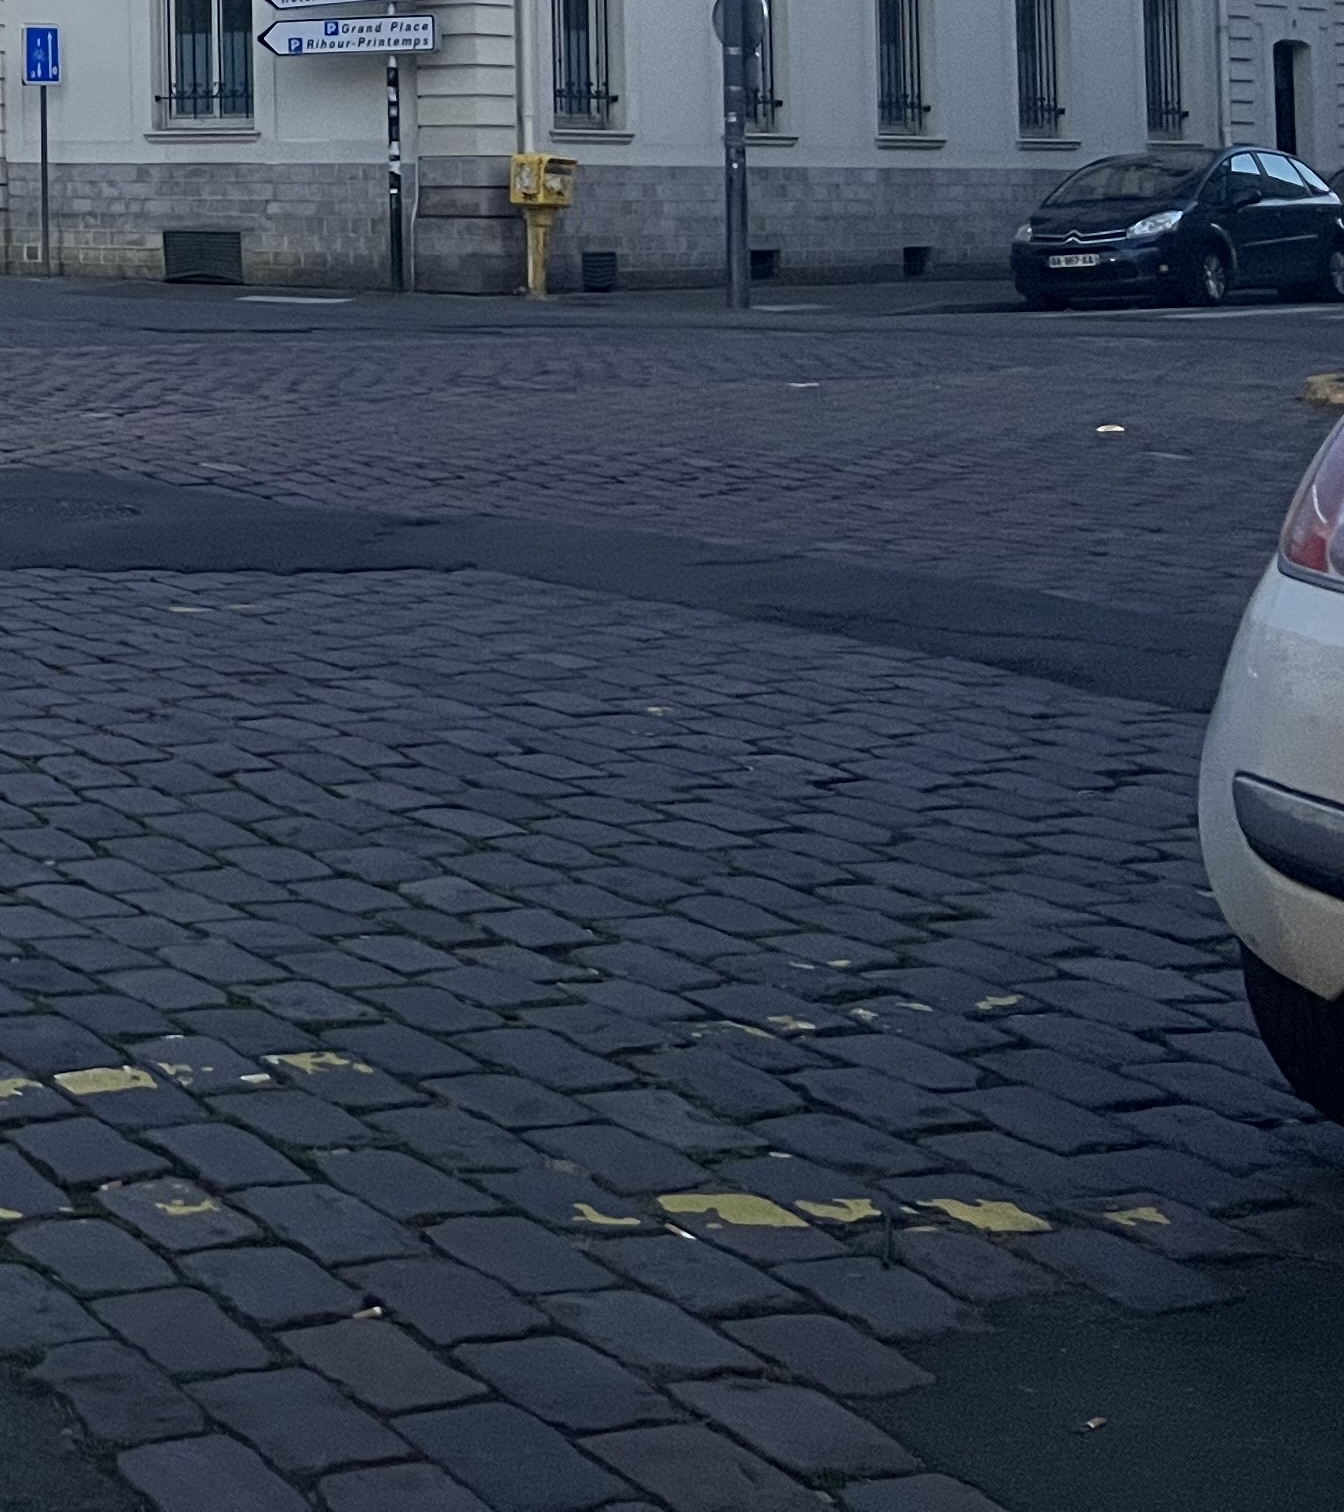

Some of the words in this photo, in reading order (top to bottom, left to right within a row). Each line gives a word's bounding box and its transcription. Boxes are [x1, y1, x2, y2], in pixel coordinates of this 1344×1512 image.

[341, 22, 382, 34] Grand
[390, 21, 429, 33] Place
[306, 37, 429, 50] Rihour-Printemps
